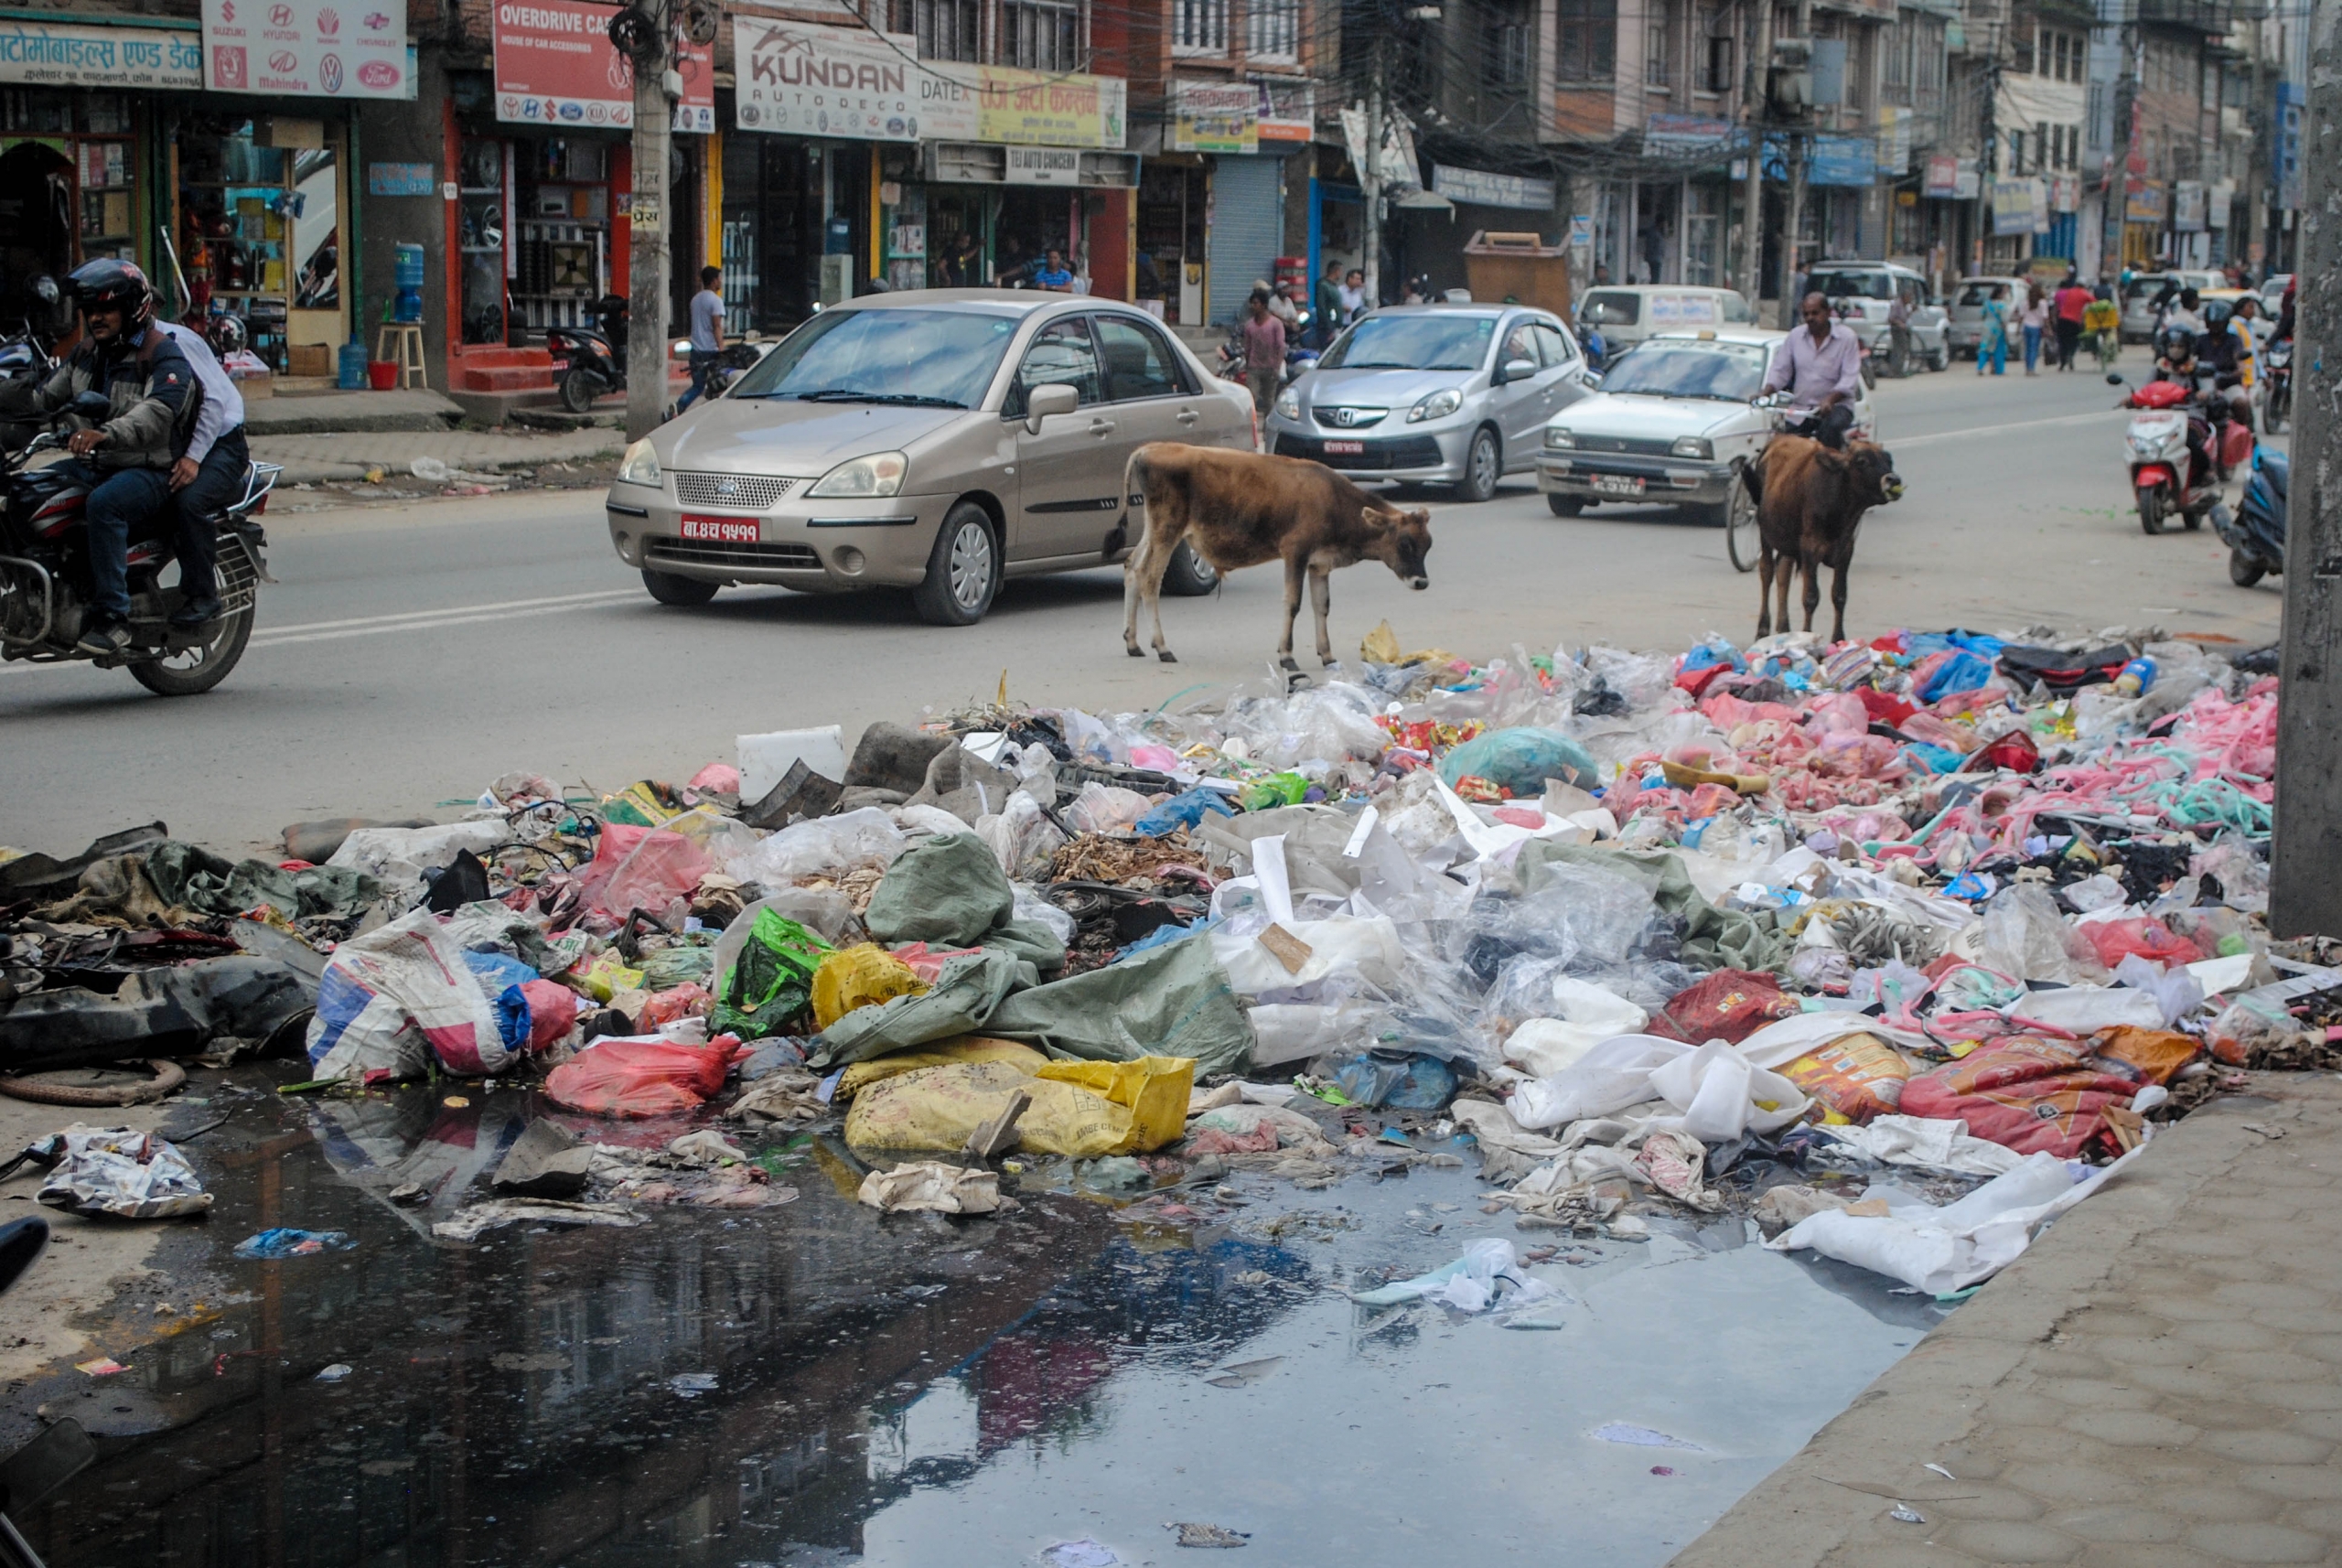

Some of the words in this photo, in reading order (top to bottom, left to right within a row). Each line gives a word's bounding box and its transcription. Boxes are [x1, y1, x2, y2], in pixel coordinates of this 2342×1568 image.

[500, 5, 583, 32] OVERDRIVE
[212, 26, 246, 38] SUZUKI
[263, 29, 301, 42] HYUNDAI
[123, 41, 162, 69] एण्ड
[169, 34, 202, 70] डेक
[259, 76, 308, 91] Mahindra
[751, 54, 906, 93] KUNDAN
[753, 89, 823, 106] AUTO
[840, 97, 906, 112] DECO
[921, 80, 971, 102] DATEX
[589, 109, 605, 119] KIA
[1024, 151, 1042, 168] AUTO
[1043, 151, 1076, 169] CONCERN
